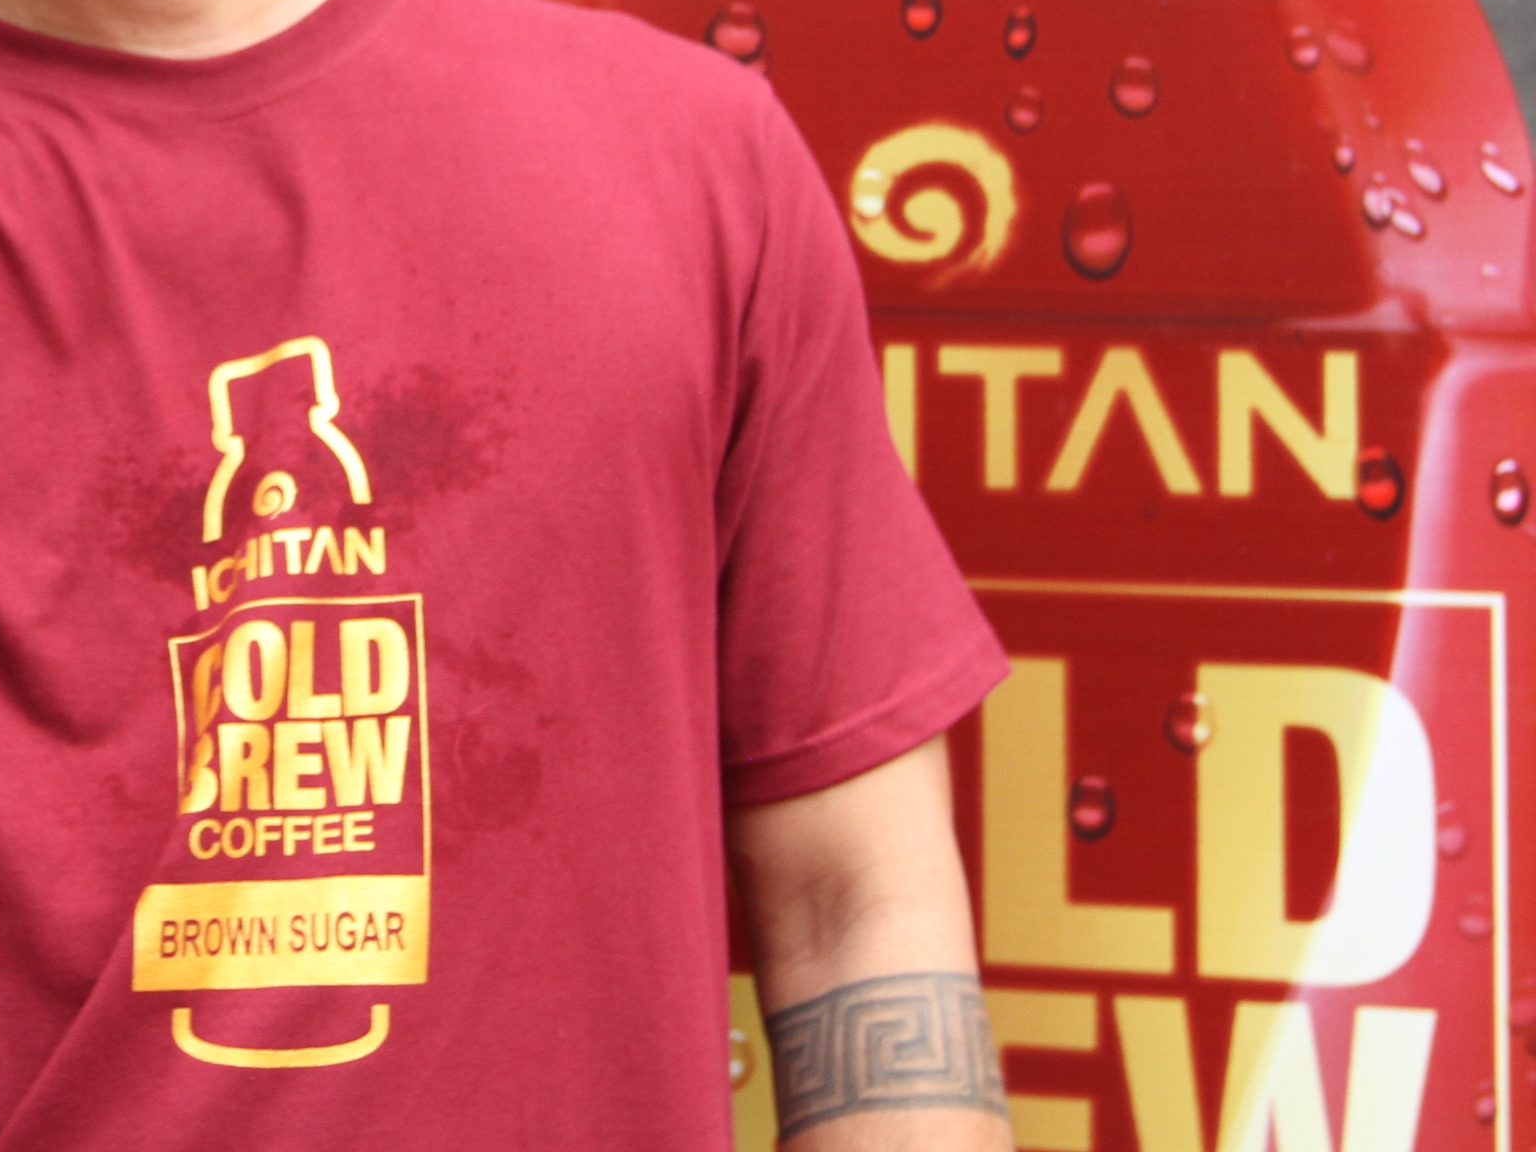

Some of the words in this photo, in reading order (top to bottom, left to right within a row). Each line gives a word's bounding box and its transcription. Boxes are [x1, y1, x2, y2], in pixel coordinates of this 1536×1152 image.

[191, 525, 386, 611] ICHITAN
[178, 715, 412, 816] BREW
[188, 811, 376, 860] COFFEE
[160, 915, 277, 959] BROWN
[288, 910, 406, 953] SUGAR
